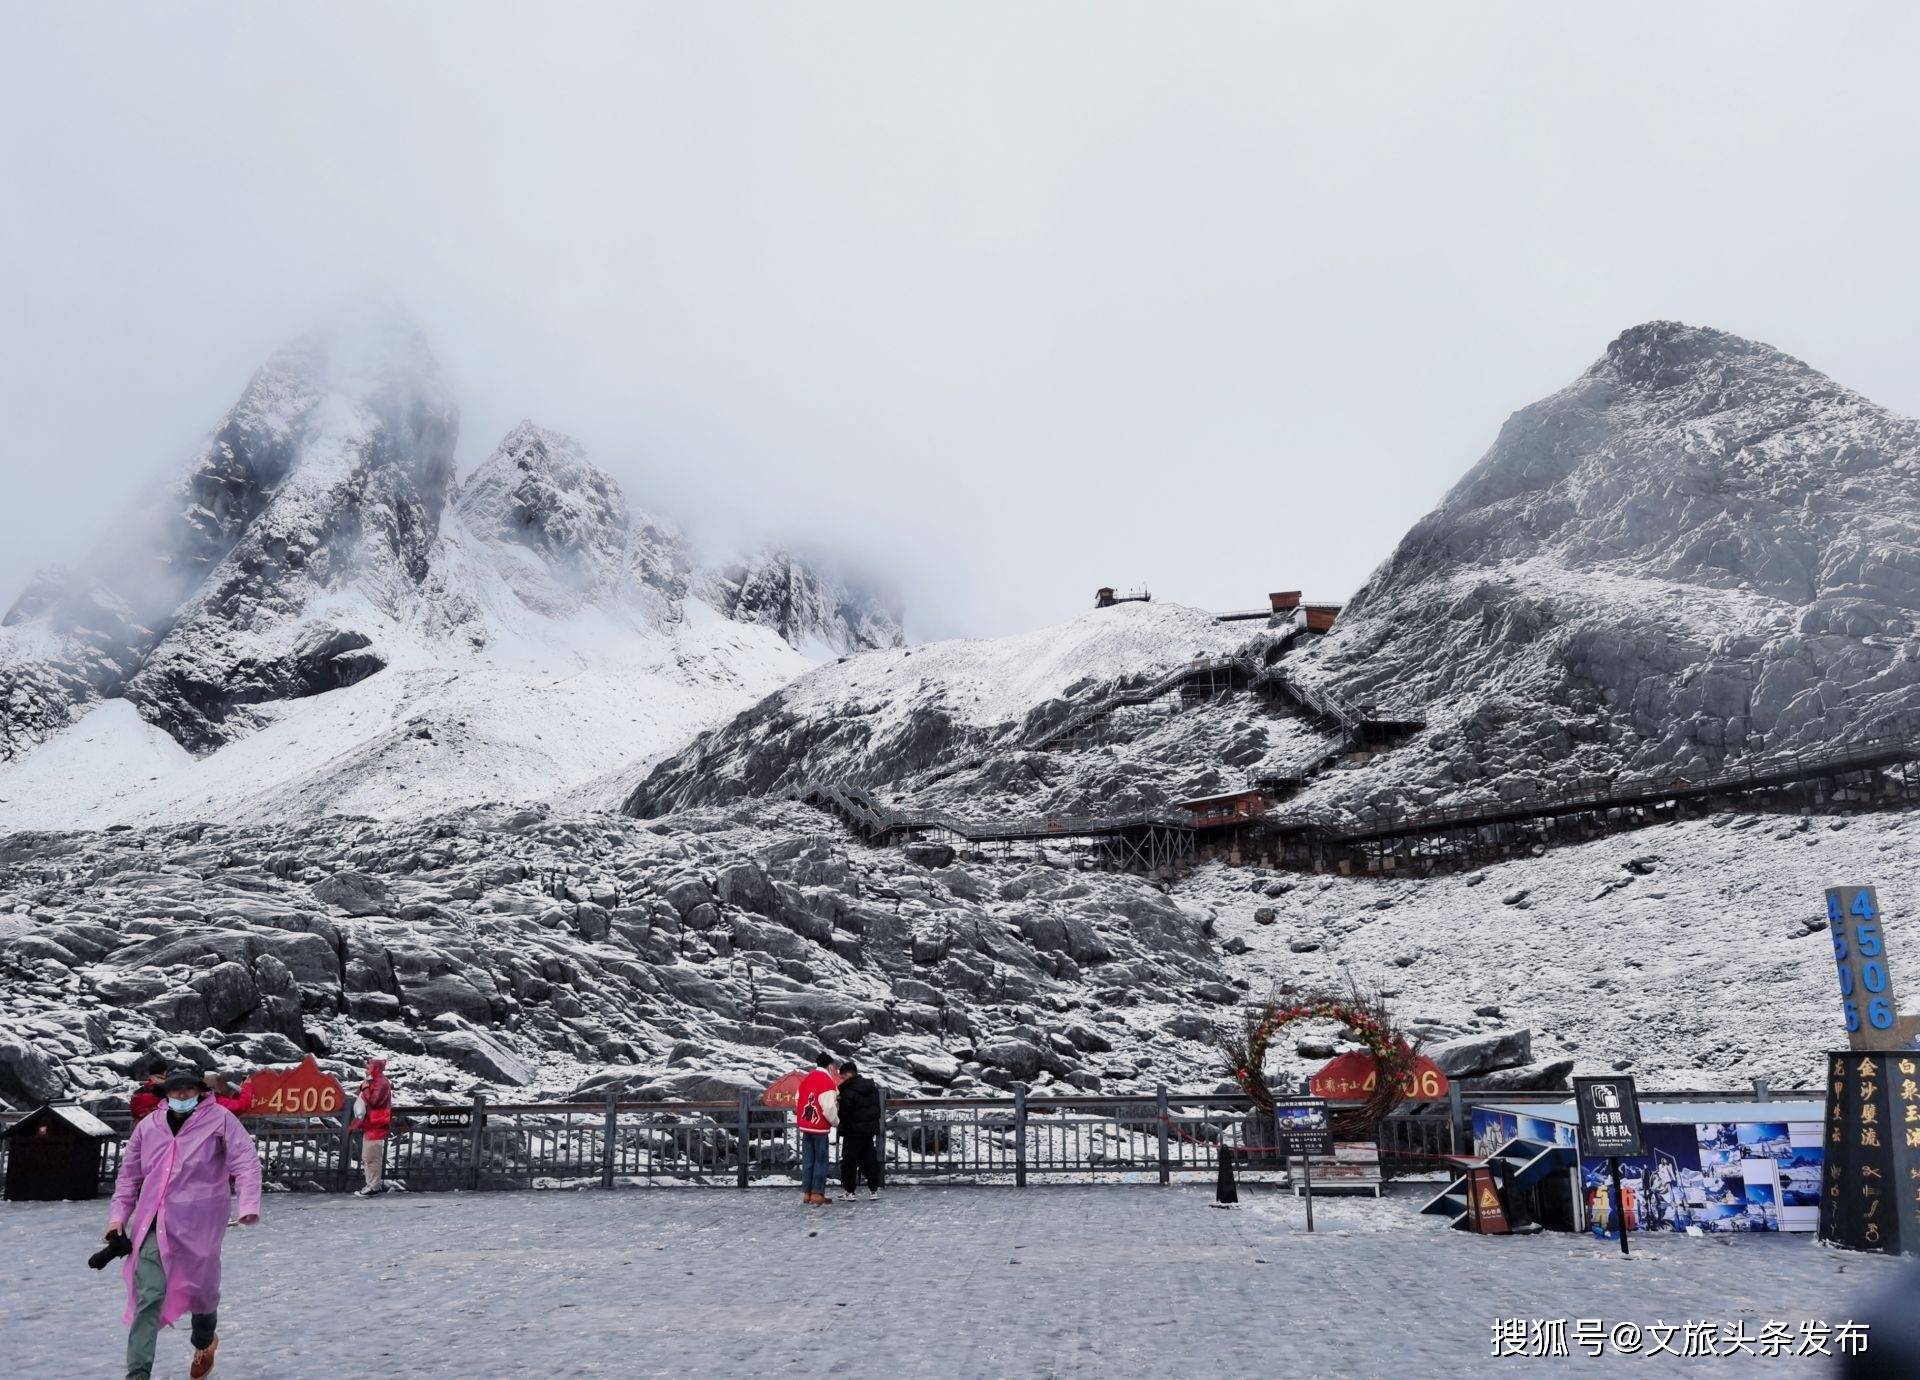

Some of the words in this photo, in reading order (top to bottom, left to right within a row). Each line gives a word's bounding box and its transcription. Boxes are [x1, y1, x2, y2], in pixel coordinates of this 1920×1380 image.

[1850, 889, 1893, 1029] 4506
[268, 1087, 336, 1112] 4506
[1596, 1112, 1622, 1123] 拍照
[1592, 1125, 1632, 1137] 请排队
